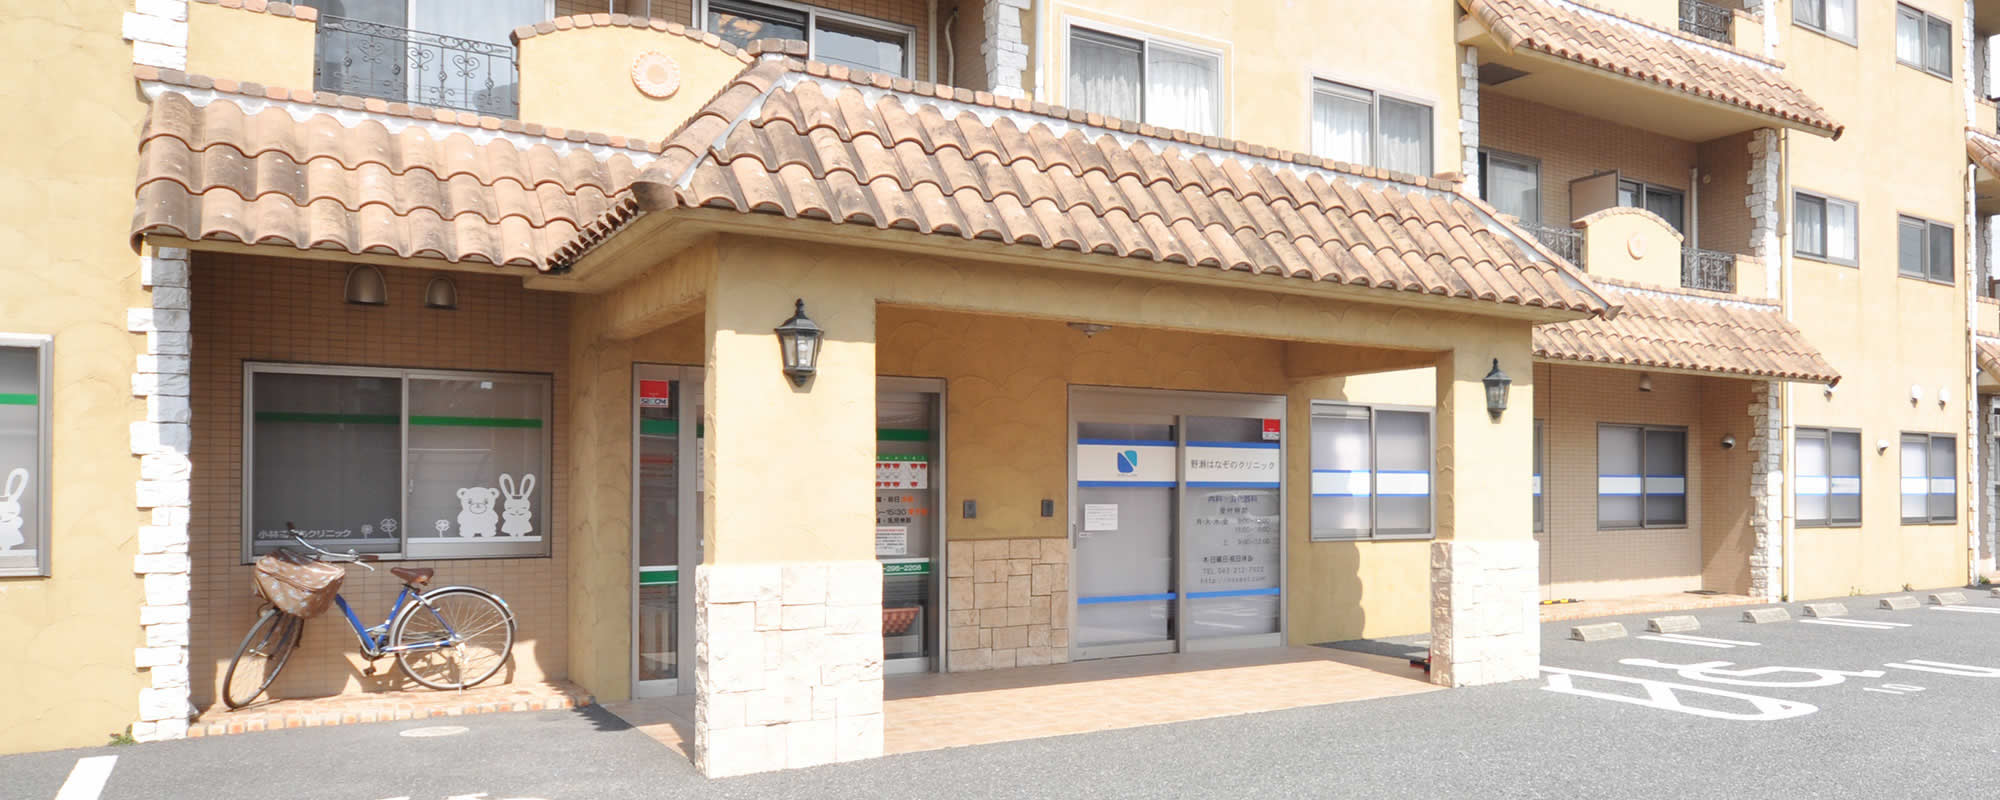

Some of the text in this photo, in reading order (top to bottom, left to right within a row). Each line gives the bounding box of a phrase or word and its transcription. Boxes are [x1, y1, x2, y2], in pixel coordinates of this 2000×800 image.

[258, 529, 352, 538] 小林こクリニック
